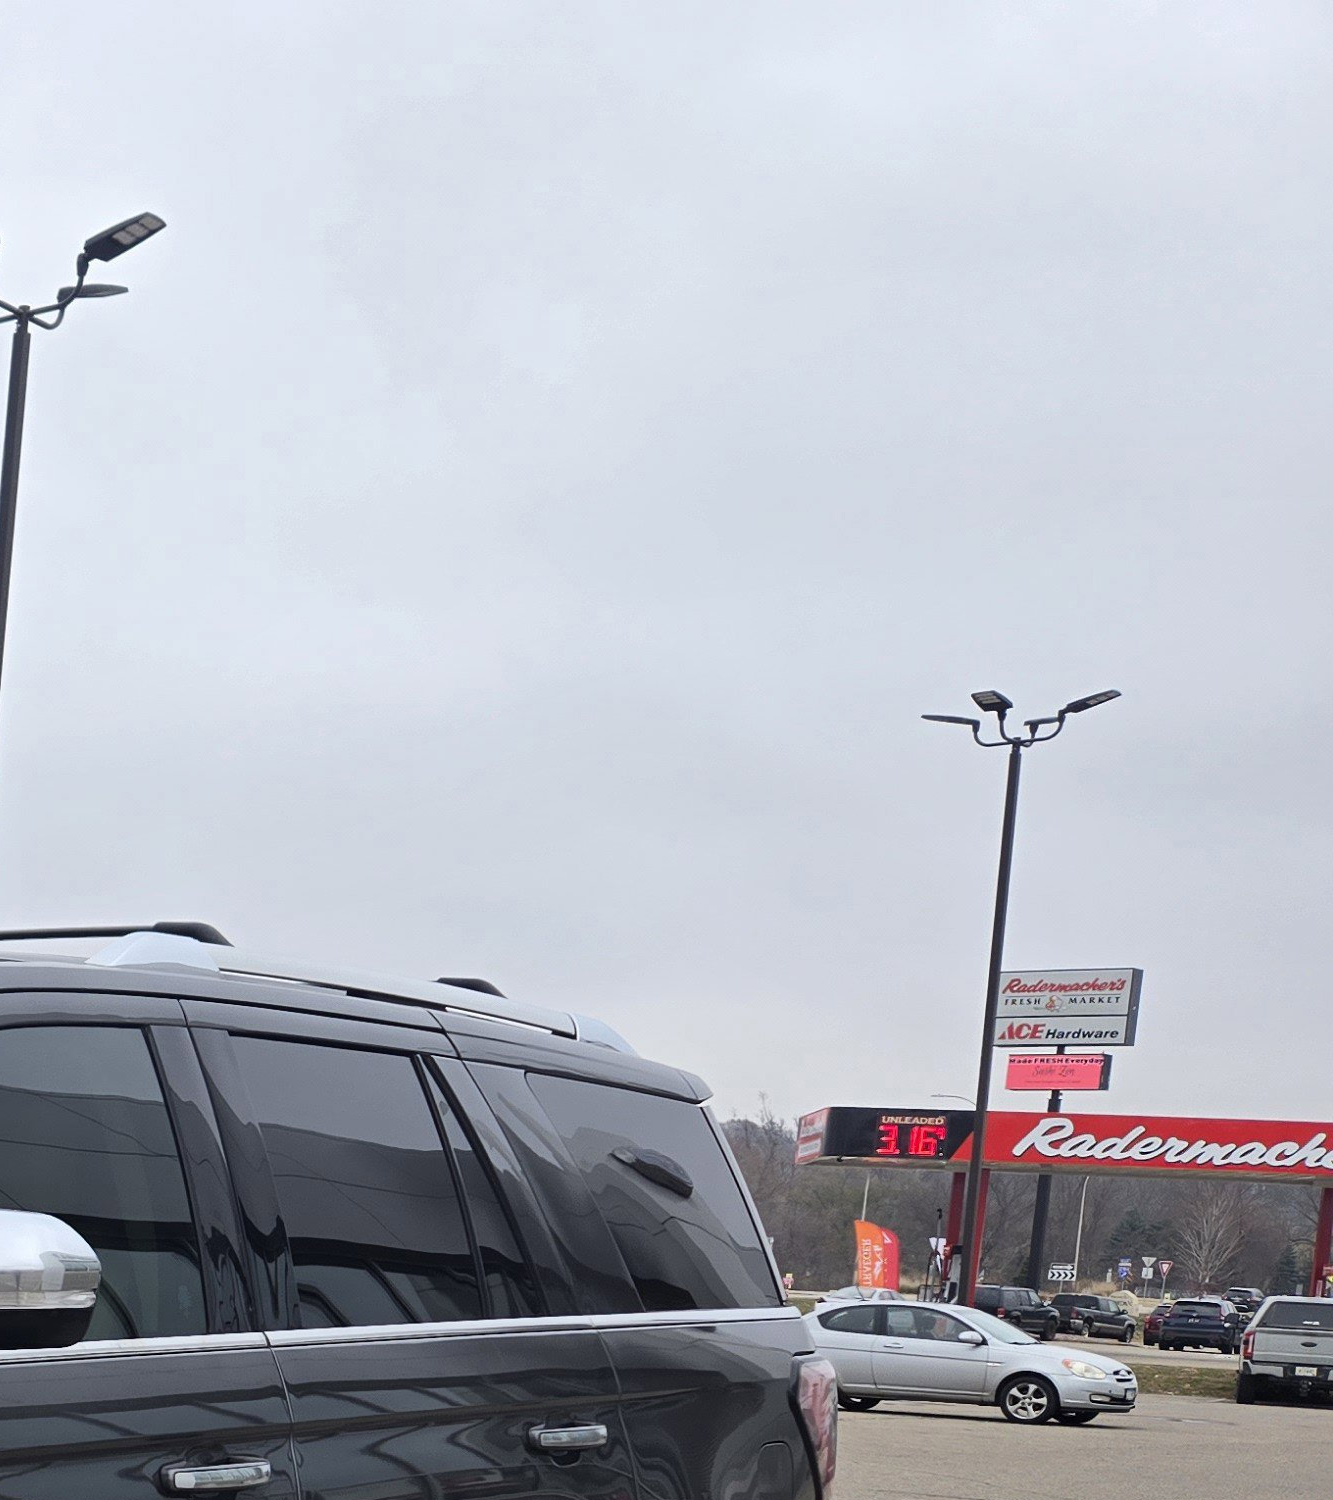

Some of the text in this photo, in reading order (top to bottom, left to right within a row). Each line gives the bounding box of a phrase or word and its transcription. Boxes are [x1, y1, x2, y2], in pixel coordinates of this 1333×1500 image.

[1002, 977, 1127, 995] Radermacher's
[1005, 996, 1121, 1006] FRESH MARKET
[998, 1021, 1119, 1040] ACE Hardware
[1065, 1057, 1104, 1065] Everyday
[882, 1115, 945, 1125] UNLEADED
